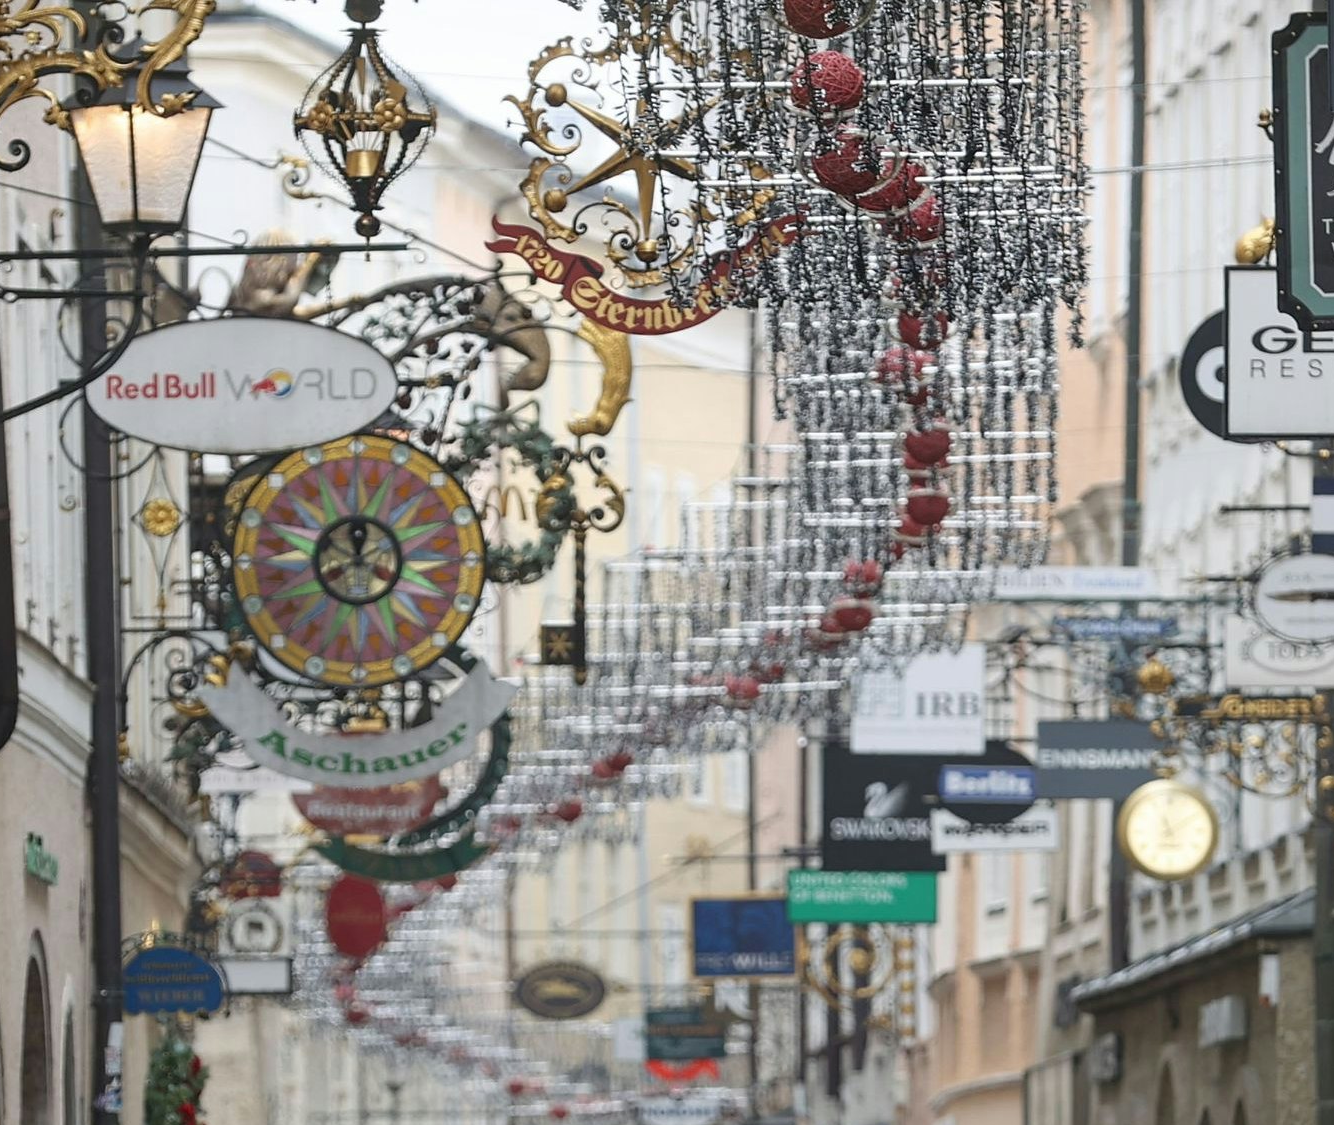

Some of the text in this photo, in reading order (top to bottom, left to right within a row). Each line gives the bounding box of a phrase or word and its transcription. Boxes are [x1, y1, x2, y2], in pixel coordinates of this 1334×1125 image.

[515, 234, 565, 281] 1720
[106, 373, 158, 399] Red
[165, 371, 215, 399] Bull
[256, 721, 469, 775] Aschauer
[943, 769, 1033, 796] Berlitz
[830, 817, 932, 840] SWAROVSK
